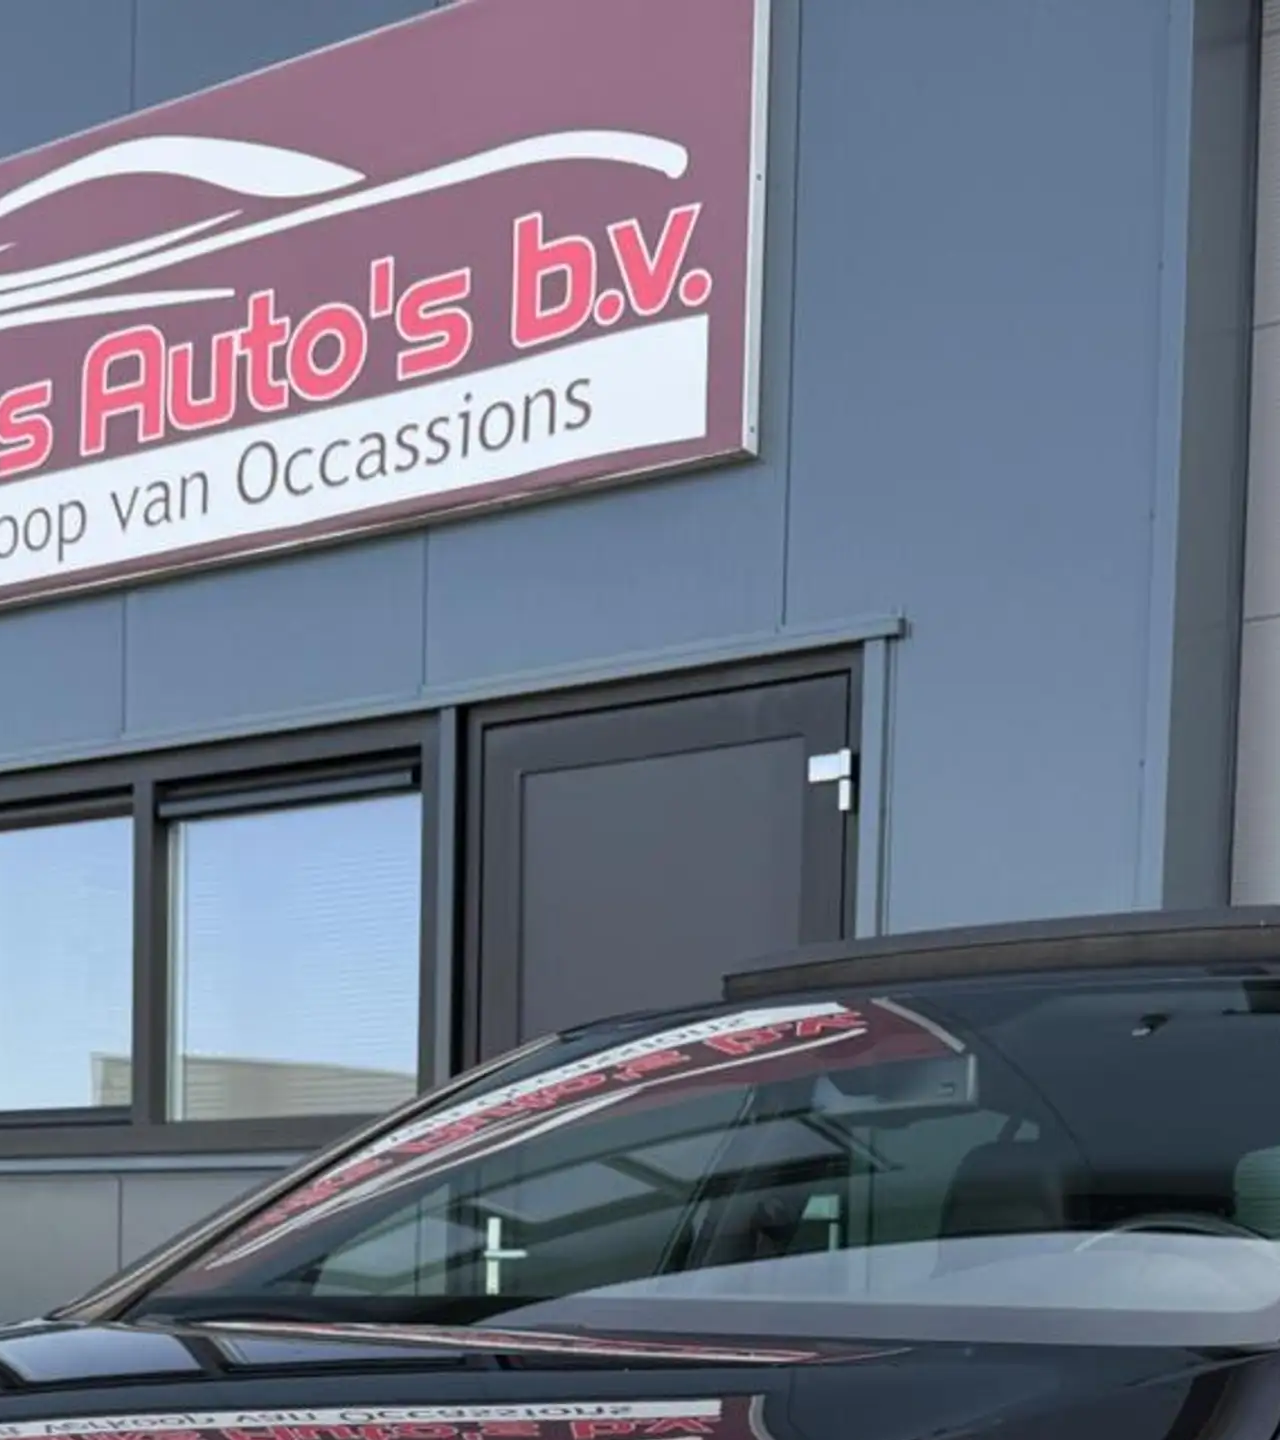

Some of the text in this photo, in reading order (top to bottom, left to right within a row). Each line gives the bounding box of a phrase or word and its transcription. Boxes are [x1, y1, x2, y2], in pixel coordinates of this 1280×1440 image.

[80, 256, 473, 457] Auto's
[512, 202, 713, 348] b.v.
[111, 470, 209, 533] van
[235, 378, 593, 504] Occassions
